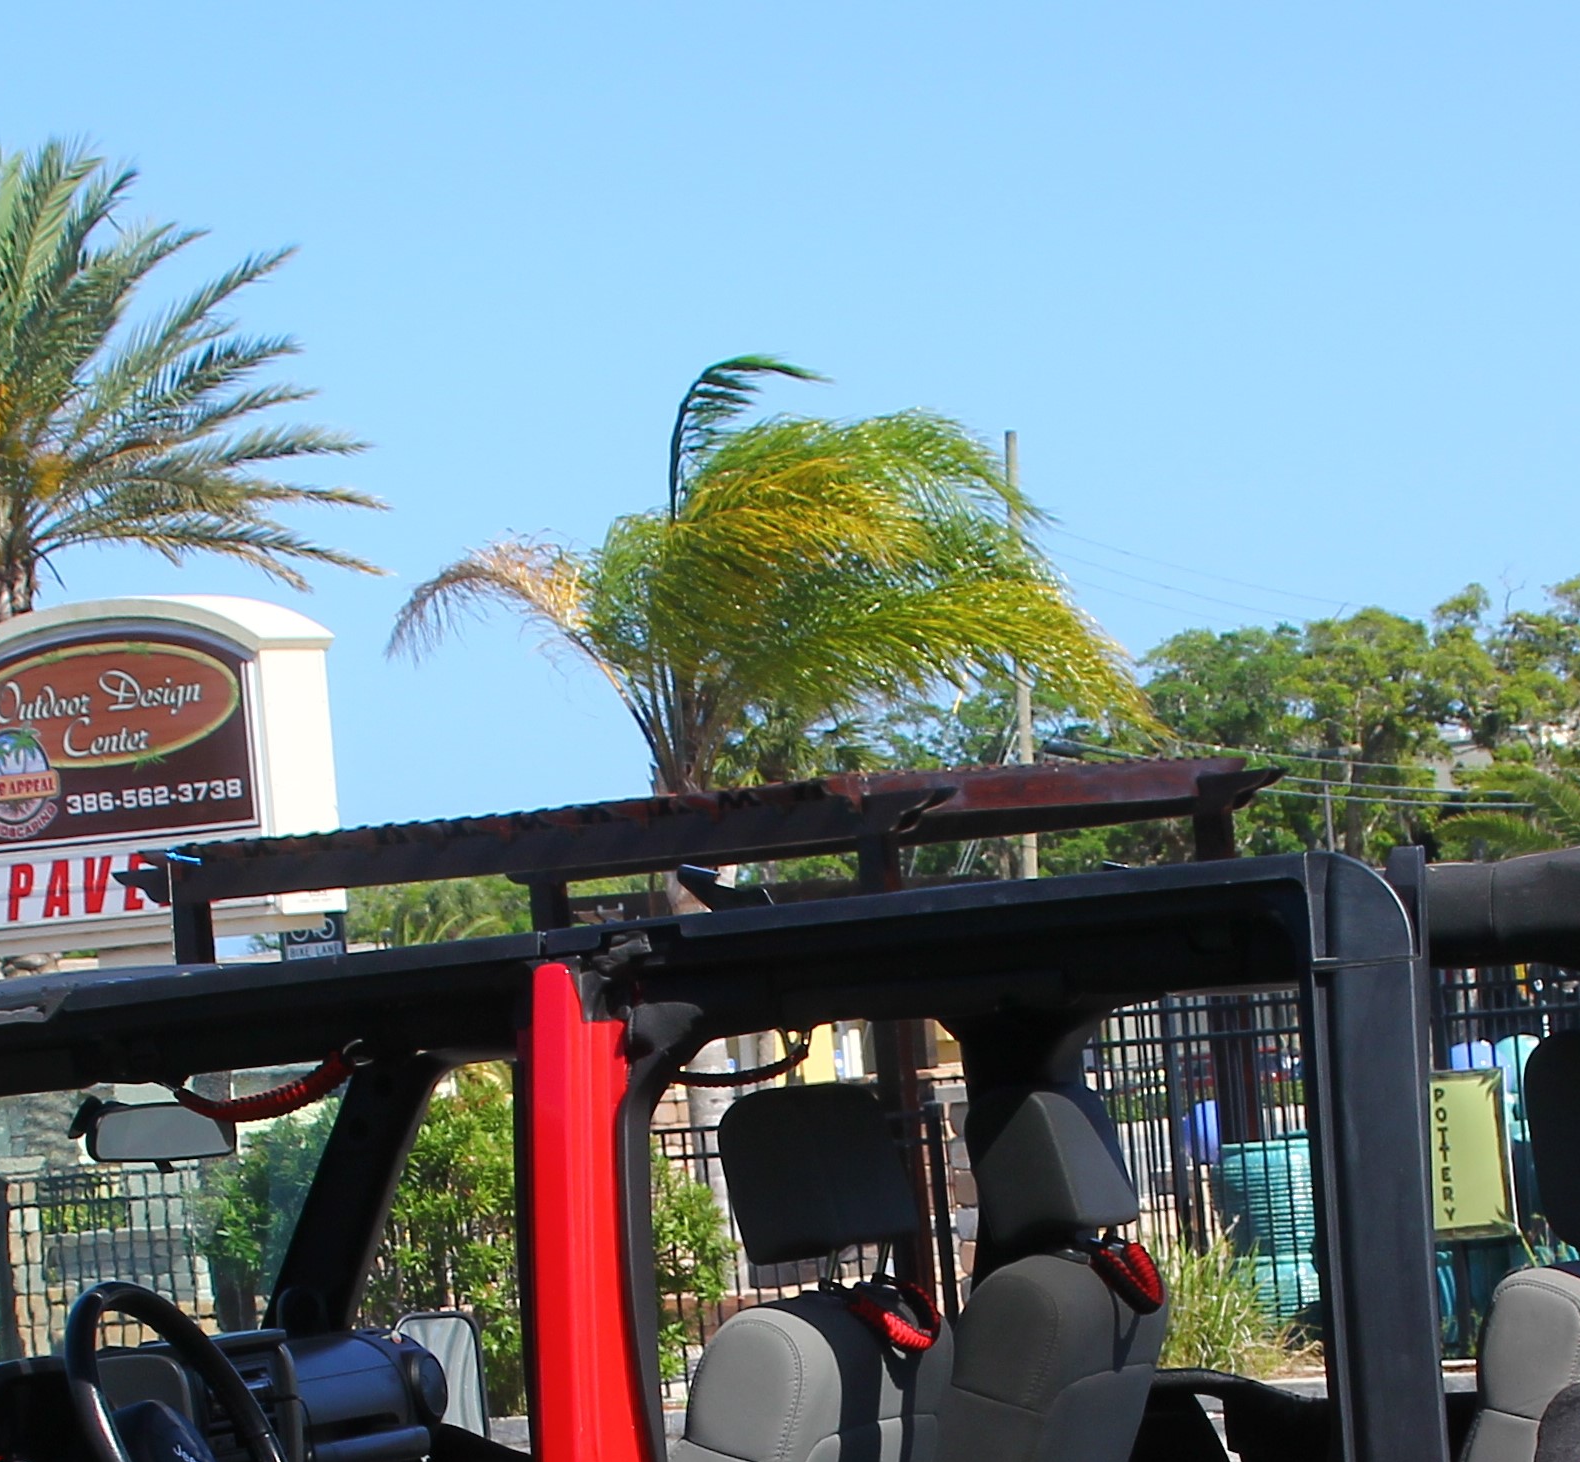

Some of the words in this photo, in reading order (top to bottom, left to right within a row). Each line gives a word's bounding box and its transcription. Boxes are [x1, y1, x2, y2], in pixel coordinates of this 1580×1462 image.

[98, 669, 201, 715] Design
[63, 716, 149, 757] Center
[10, 778, 54, 795] APPEAL
[1433, 1087, 1456, 1222] POTTERY
